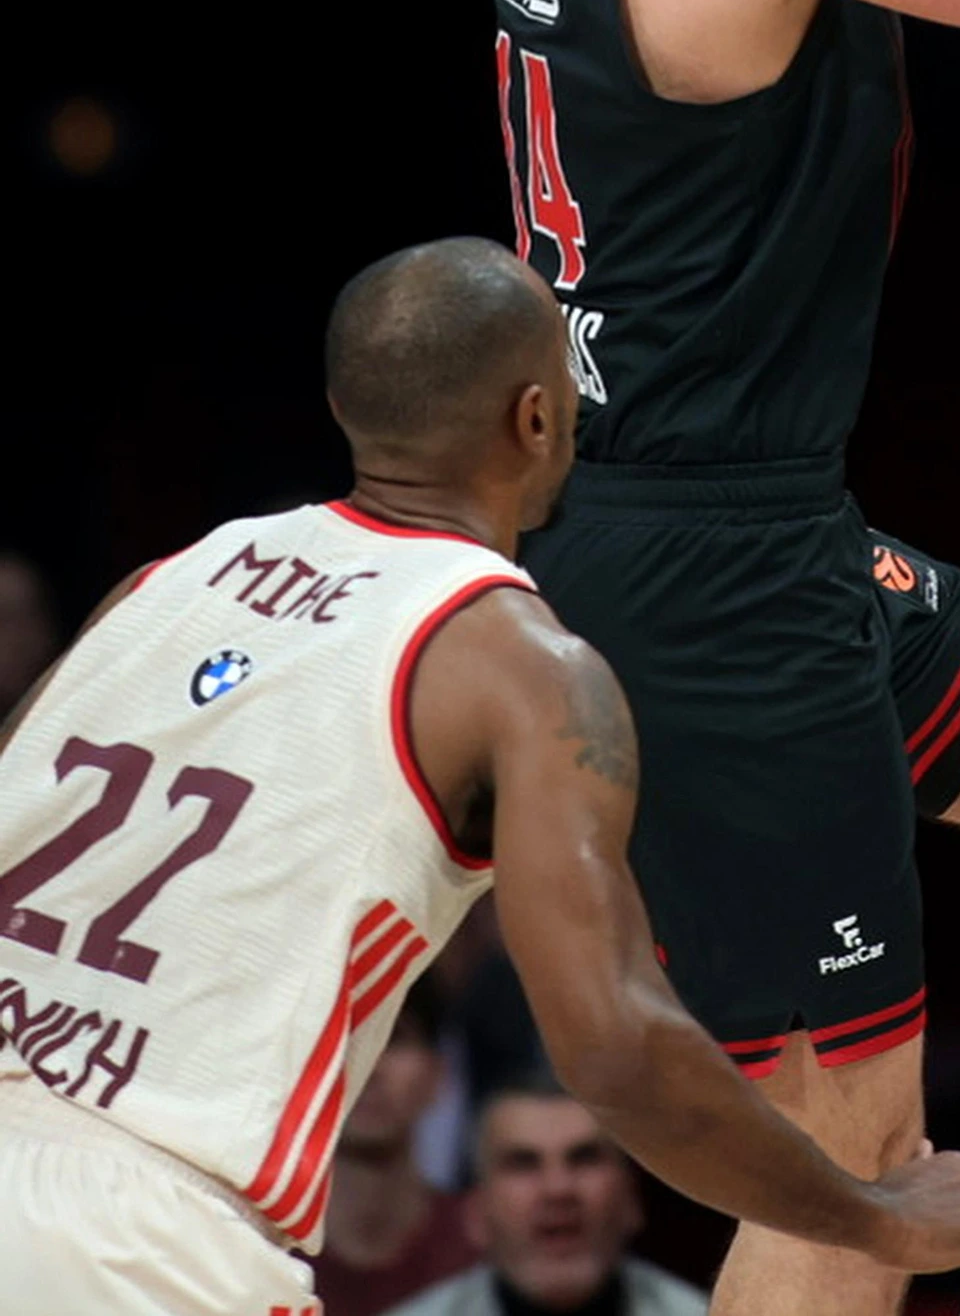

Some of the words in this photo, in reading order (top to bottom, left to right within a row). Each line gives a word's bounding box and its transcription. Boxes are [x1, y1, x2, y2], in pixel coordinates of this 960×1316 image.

[495, 29, 586, 290] 14
[0, 736, 254, 985] 22
[819, 942, 885, 975] FlexCar
